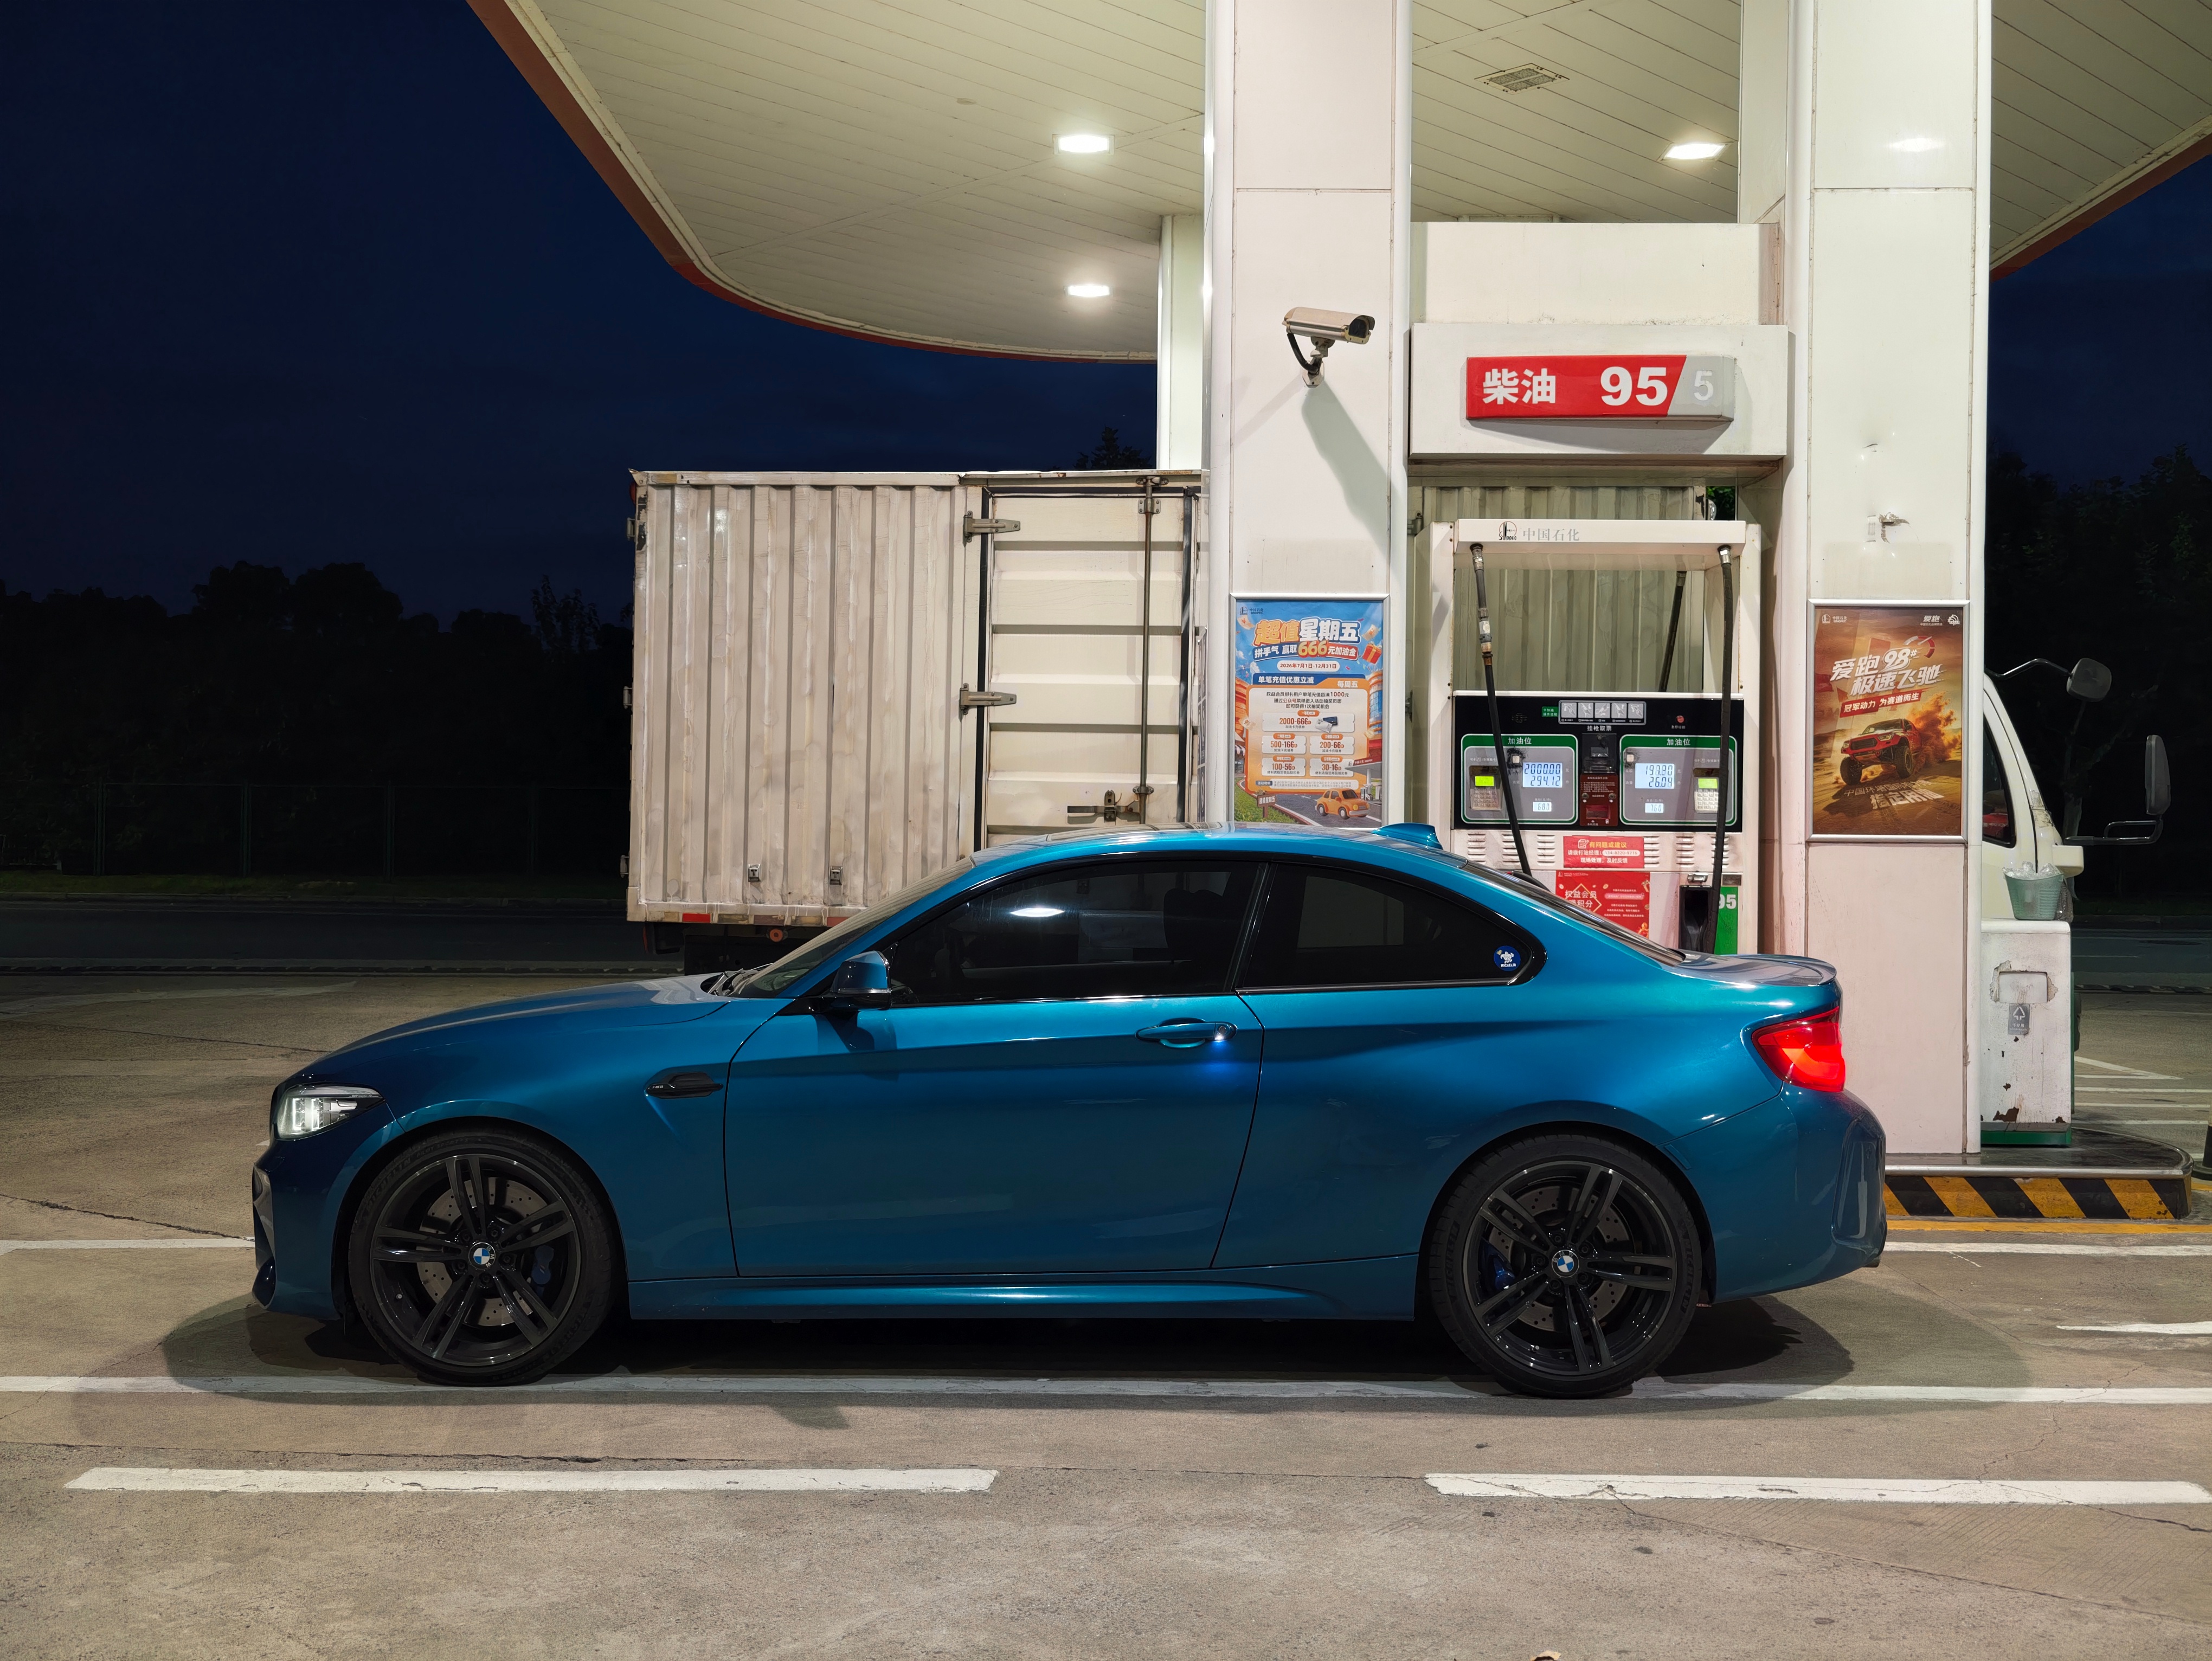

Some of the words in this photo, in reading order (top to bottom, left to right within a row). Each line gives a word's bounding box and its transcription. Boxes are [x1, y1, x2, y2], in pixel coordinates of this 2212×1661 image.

[1482, 368, 1556, 405] 柴油
[1600, 365, 1669, 407] 95
[1693, 369, 1714, 401] 5
[1523, 527, 1580, 541] 中国石化
[1255, 618, 1359, 645] 超值星期五
[1255, 646, 1279, 659] 拼手气
[1850, 665, 1943, 696] 极速飞驰
[1843, 700, 1876, 713] 冠军动力
[1879, 692, 1920, 707] 为赛道而生
[1508, 737, 1532, 745] 加油位
[1666, 738, 1691, 746] 加油位
[1524, 763, 1561, 775] 2000.00
[1531, 775, 1561, 787] 294.12
[1565, 890, 1597, 899] 权益会员
